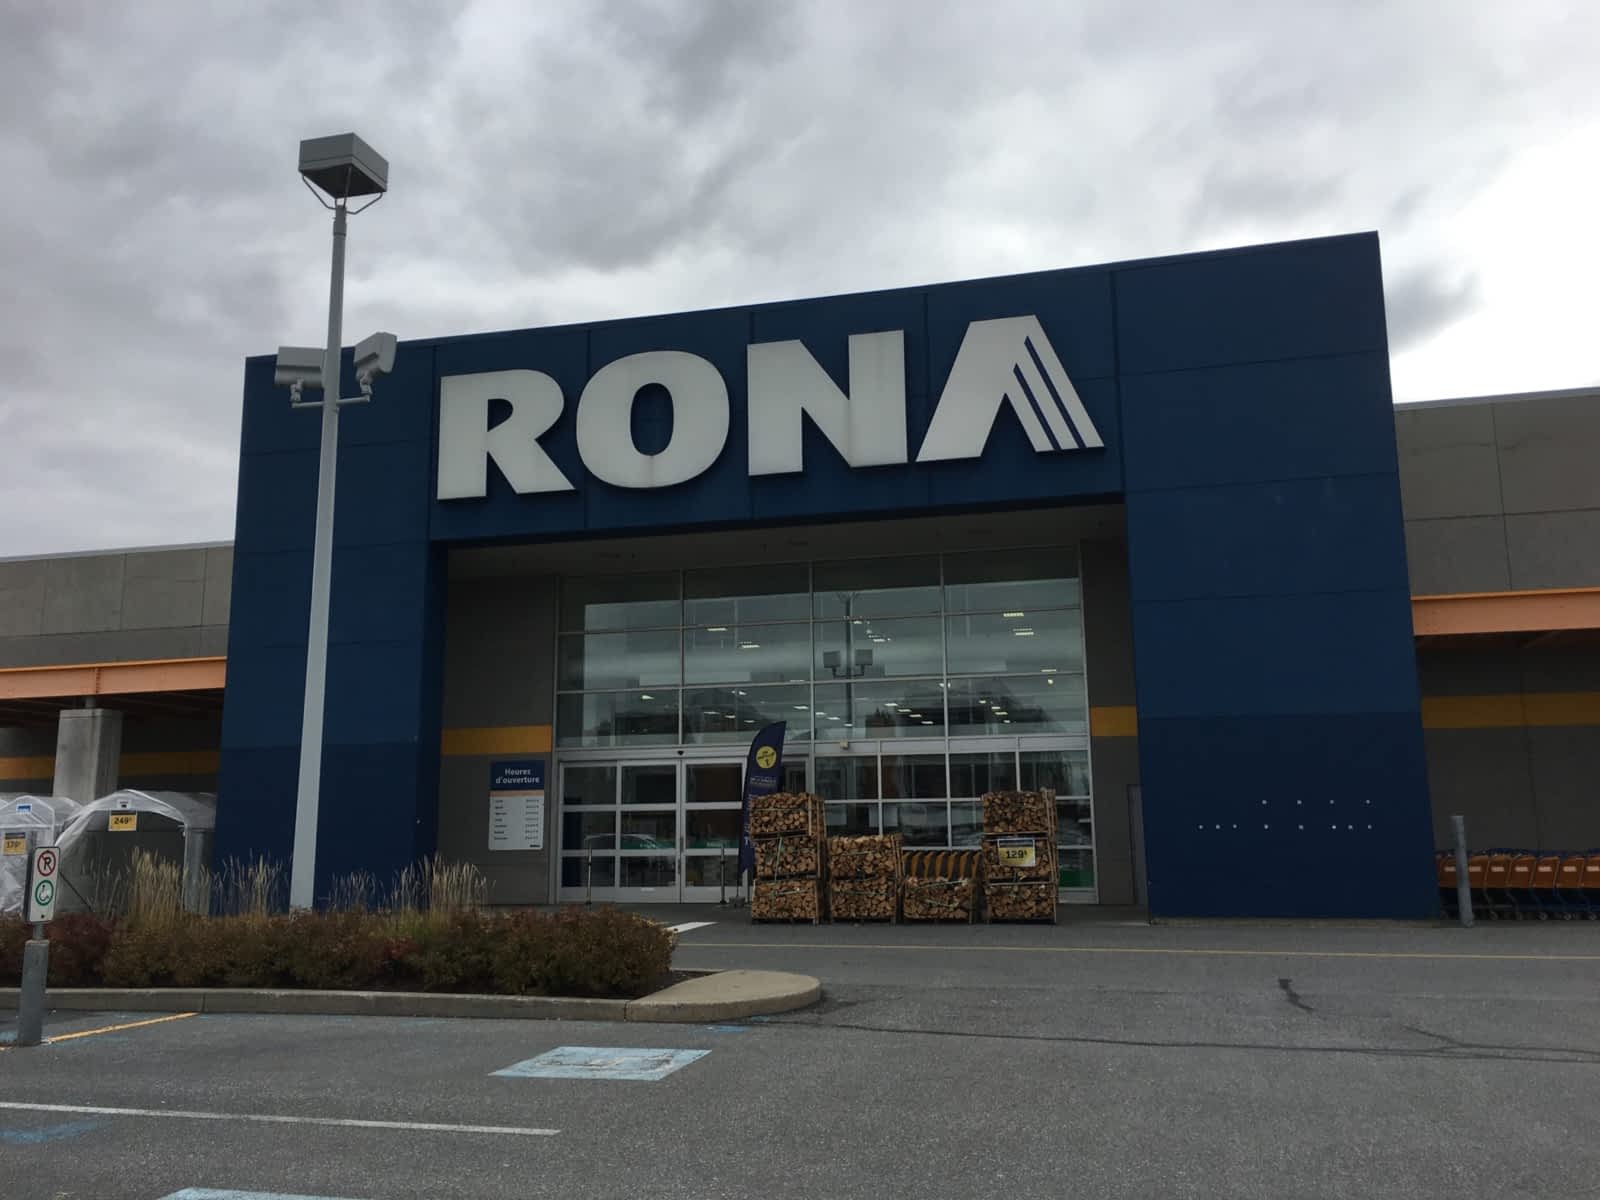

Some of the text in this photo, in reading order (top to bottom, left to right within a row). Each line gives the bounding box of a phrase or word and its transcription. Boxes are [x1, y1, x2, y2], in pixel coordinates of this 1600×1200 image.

[437, 314, 1105, 501] RONA
[504, 768, 531, 776] Heures
[495, 776, 540, 784] d'ouverture
